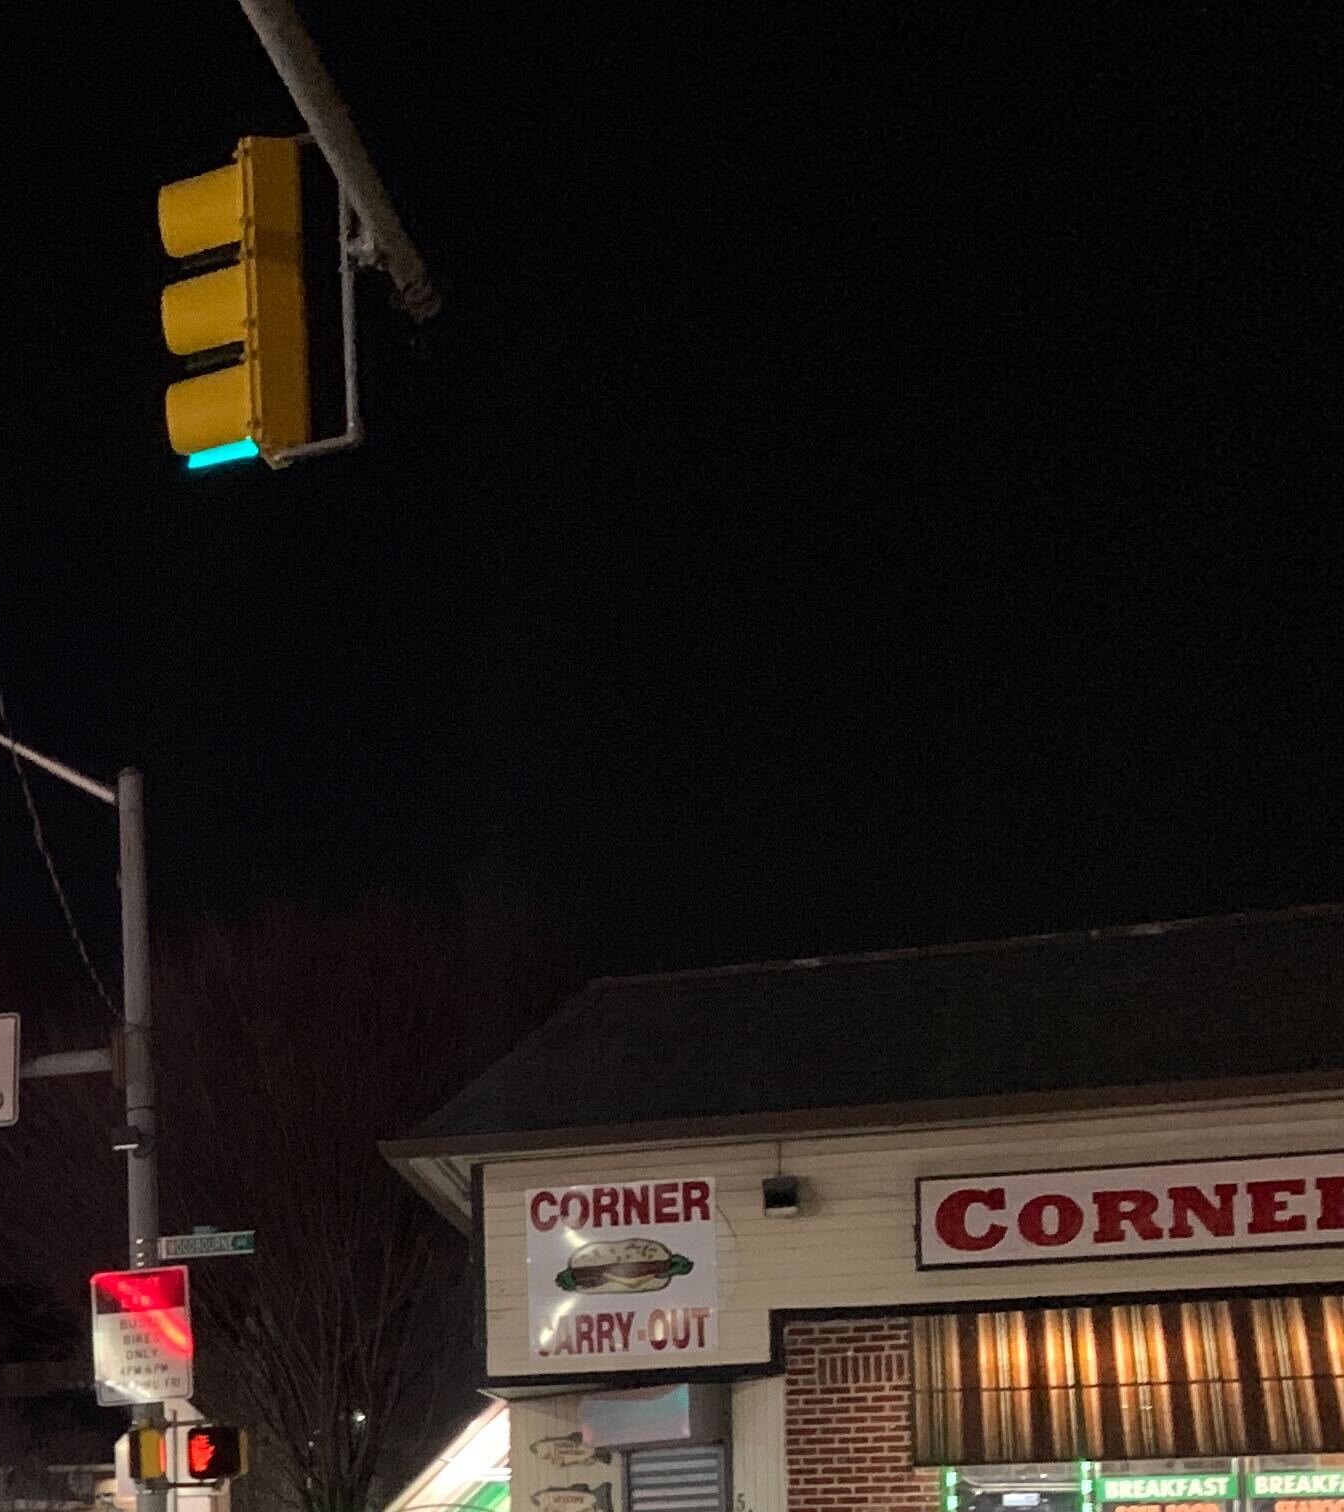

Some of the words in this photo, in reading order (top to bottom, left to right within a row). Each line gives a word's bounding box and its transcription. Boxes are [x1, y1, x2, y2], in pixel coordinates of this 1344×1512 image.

[531, 1181, 711, 1232] CORNER
[537, 1307, 710, 1357] ARRY-OUT
[1103, 1476, 1230, 1499] BREAKFAST
[1254, 1474, 1344, 1496] BREAKF
